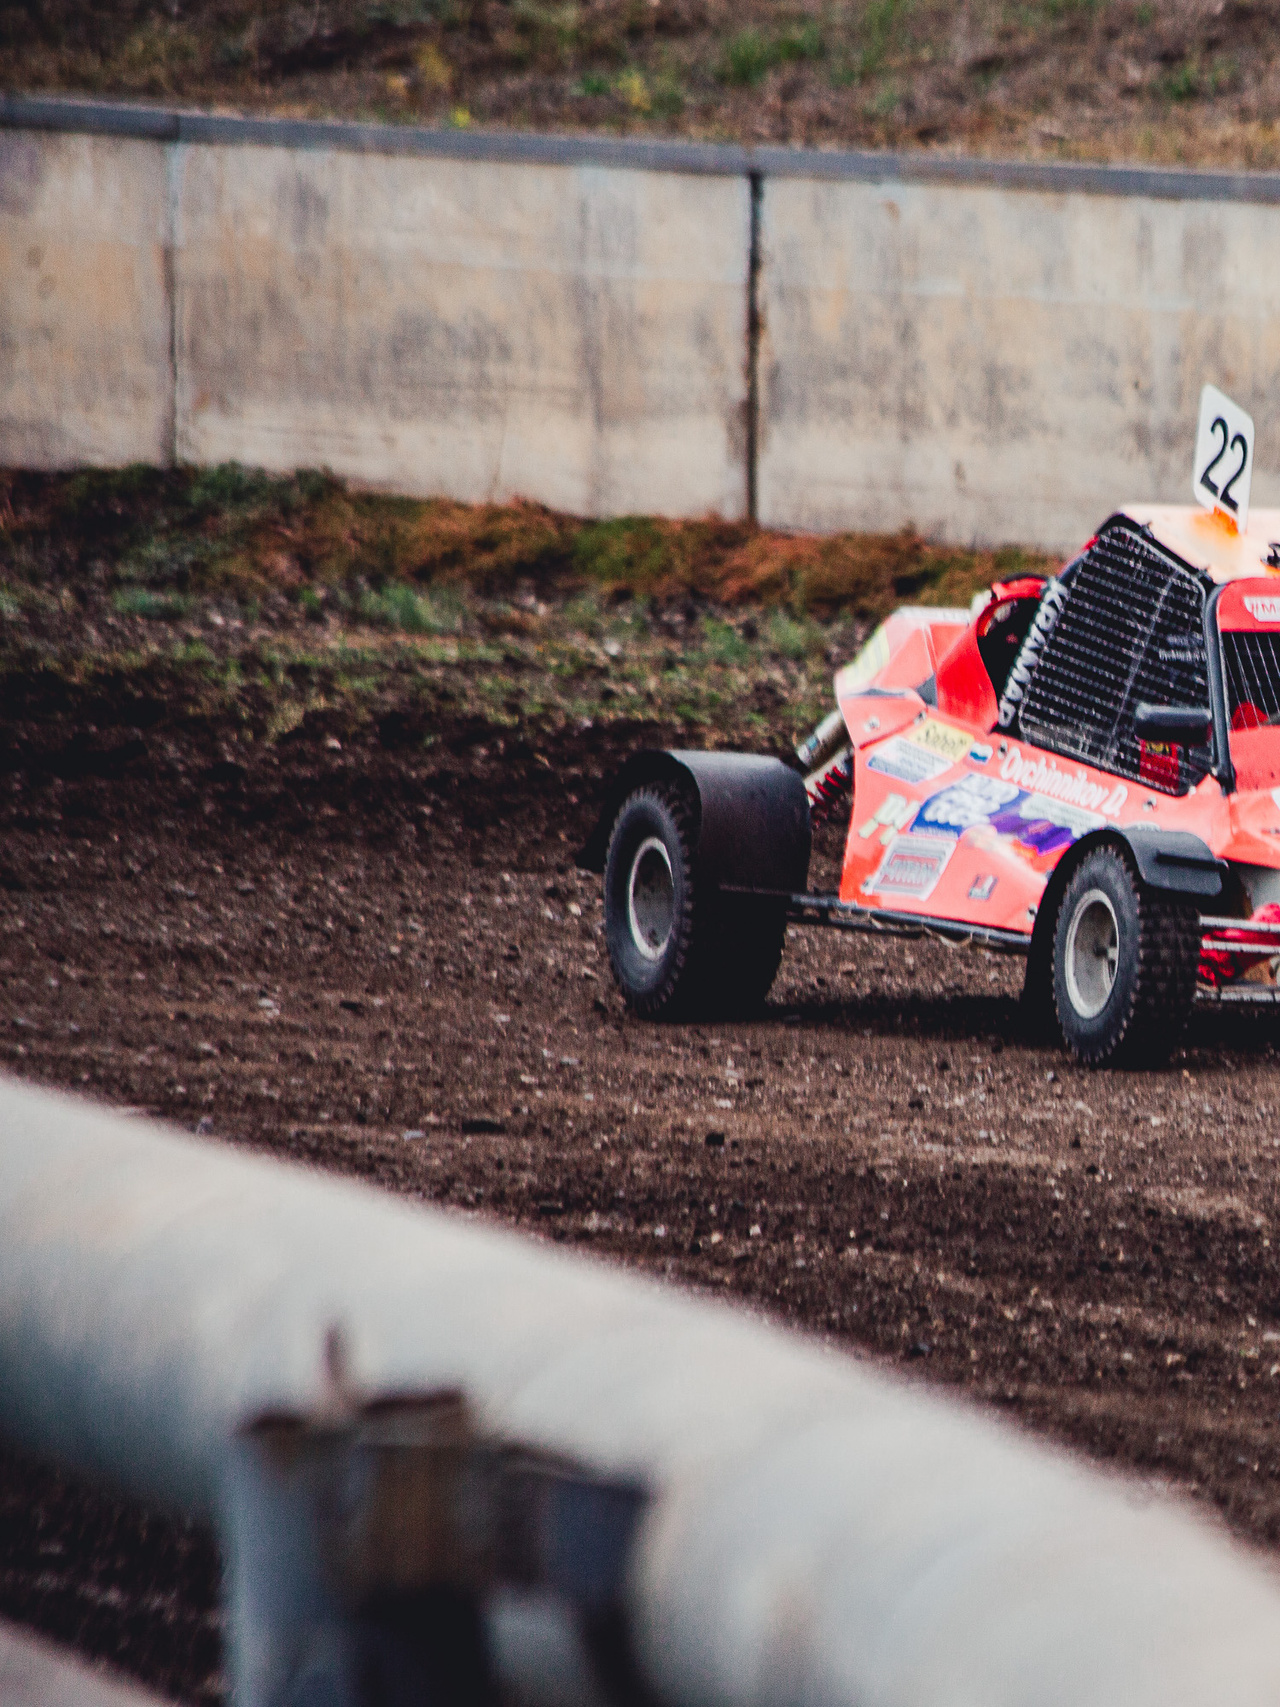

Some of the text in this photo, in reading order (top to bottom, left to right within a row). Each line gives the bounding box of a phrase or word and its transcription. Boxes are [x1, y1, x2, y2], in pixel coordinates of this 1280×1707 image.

[1200, 416, 1249, 511] 22
[998, 577, 1069, 728] KRAMAR
[1001, 747, 1109, 810] Ovchinnikov
